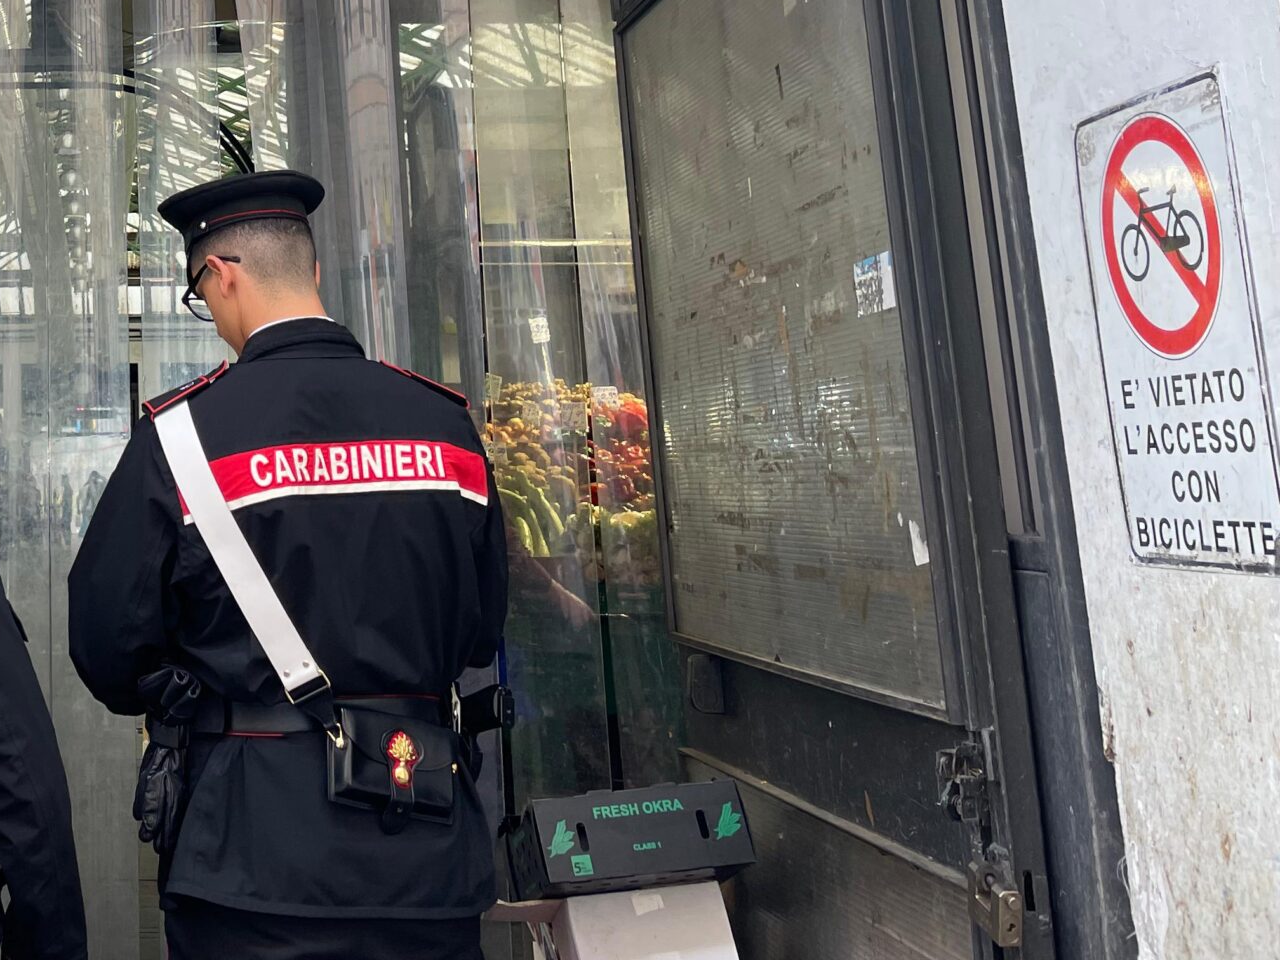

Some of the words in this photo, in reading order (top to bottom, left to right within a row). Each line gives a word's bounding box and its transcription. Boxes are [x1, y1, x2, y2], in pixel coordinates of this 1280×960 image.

[1121, 378, 1139, 409] E'
[1148, 367, 1245, 407] VIETATO
[1124, 418, 1256, 456] L'ACCESSO
[249, 444, 446, 487] CARABINIERI
[1172, 470, 1221, 503] CON
[1136, 517, 1276, 556] BICICLETTE
[592, 803, 640, 819] FRESH
[642, 798, 684, 814] OKRA
[633, 841, 657, 851] CLASS
